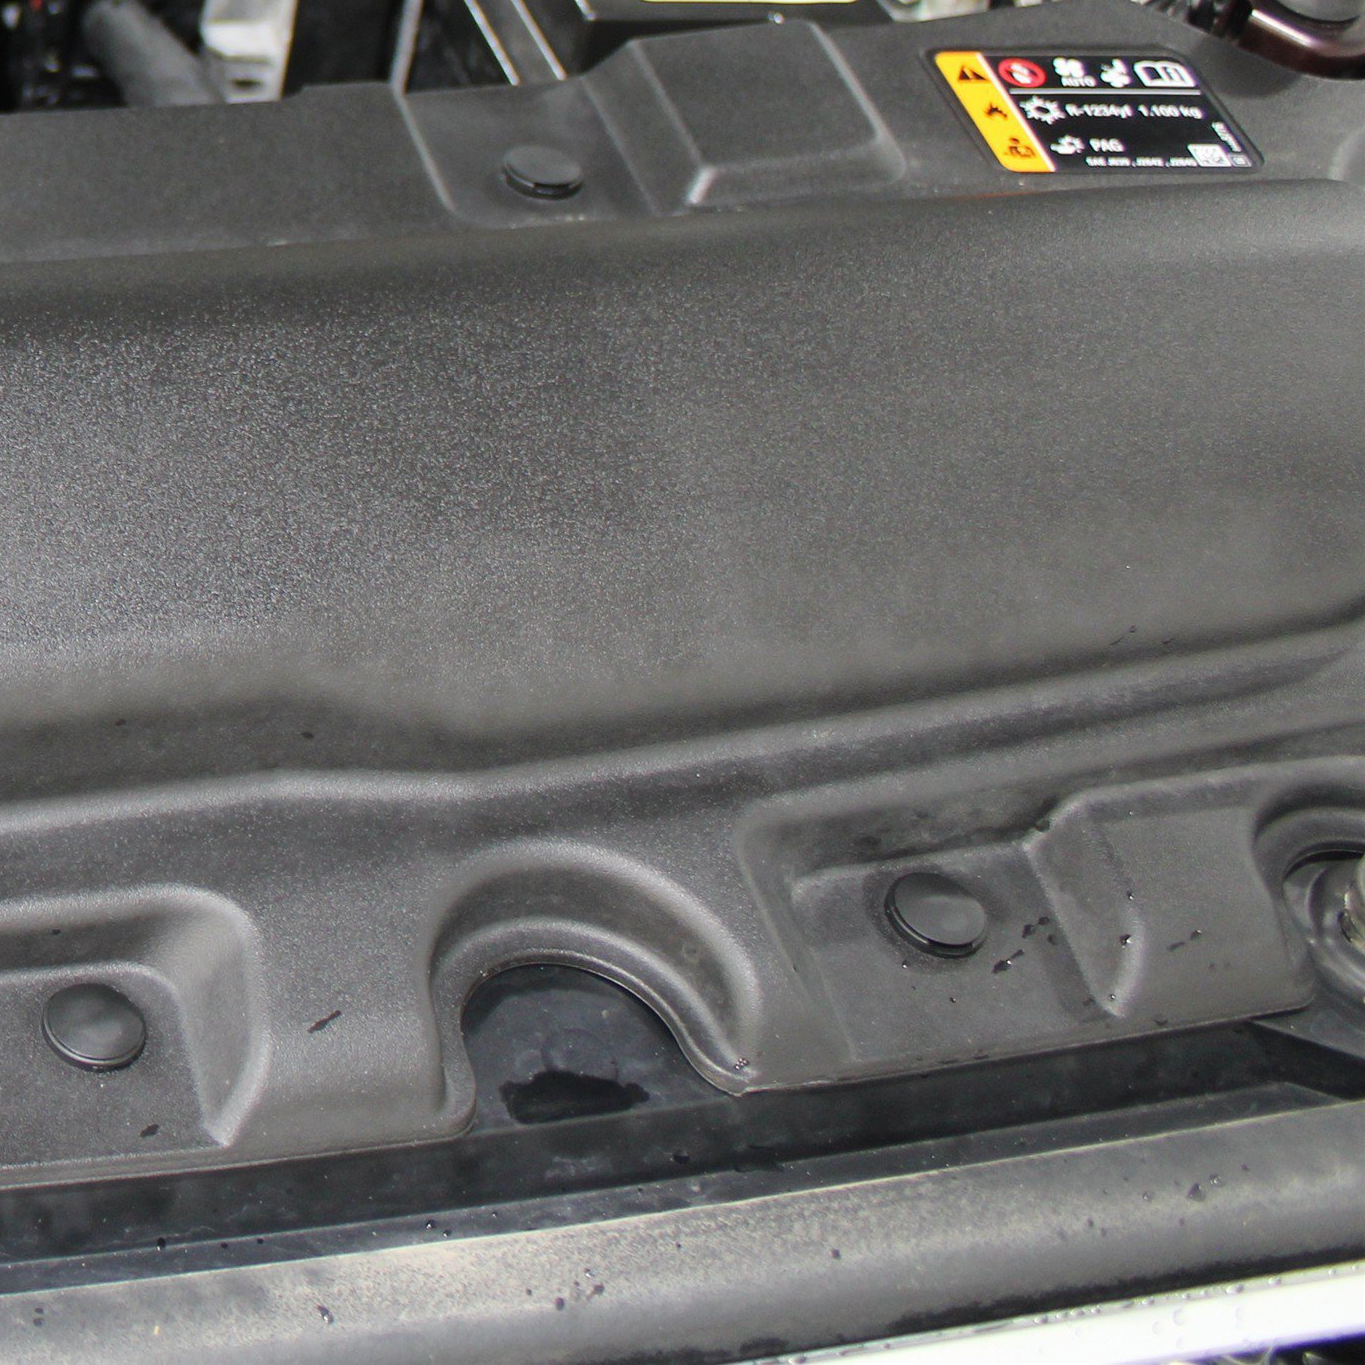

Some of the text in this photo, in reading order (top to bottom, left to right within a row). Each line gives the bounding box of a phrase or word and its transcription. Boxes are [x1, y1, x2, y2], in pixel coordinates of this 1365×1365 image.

[1062, 76, 1096, 87] AUTO
[1066, 104, 1204, 119] R-1234yf 1.100 kg
[1089, 138, 1125, 152] PAG
